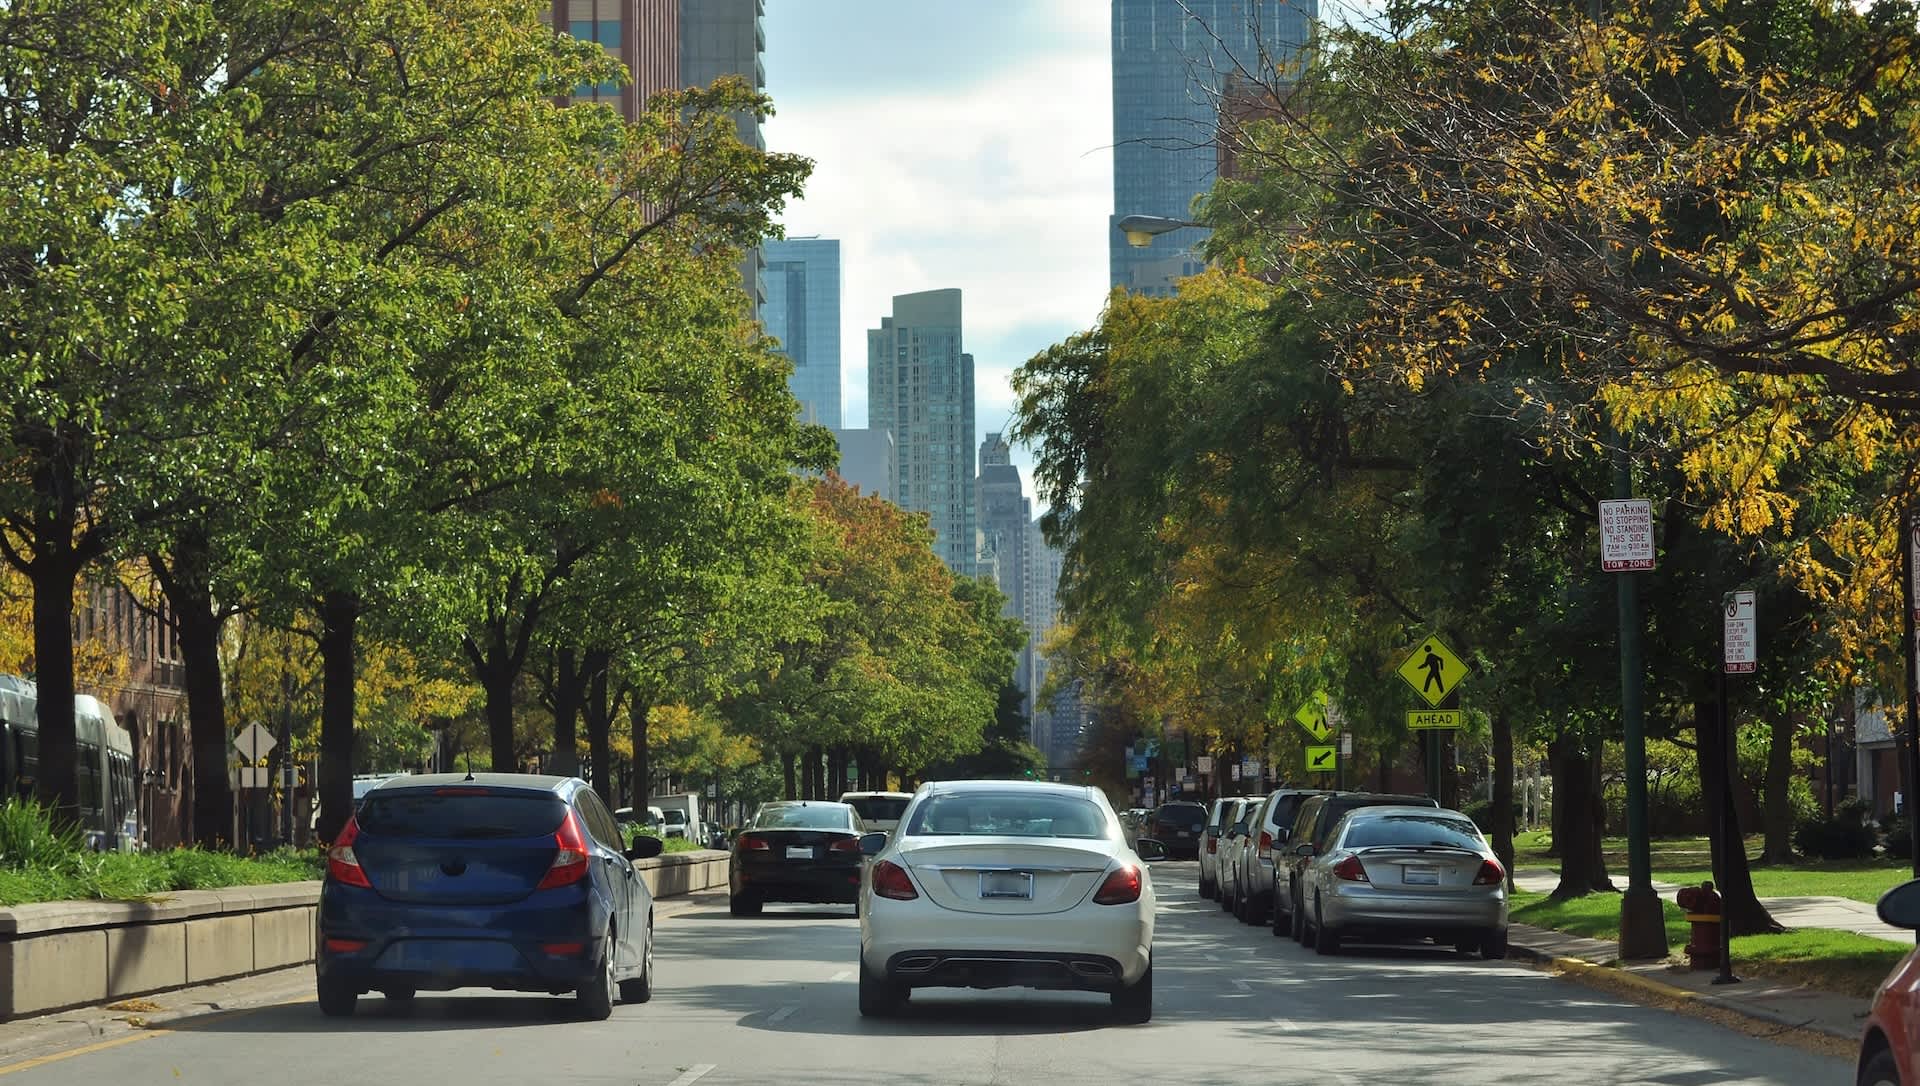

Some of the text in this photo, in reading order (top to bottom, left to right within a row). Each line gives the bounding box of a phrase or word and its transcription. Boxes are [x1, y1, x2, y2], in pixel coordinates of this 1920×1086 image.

[1604, 506, 1648, 515] NO PARKING
[1604, 515, 1648, 525] NO STOPPING
[1605, 525, 1649, 534] NO STANDING
[1609, 534, 1645, 543] THIS SIDE
[1416, 714, 1452, 725] AHEAD
